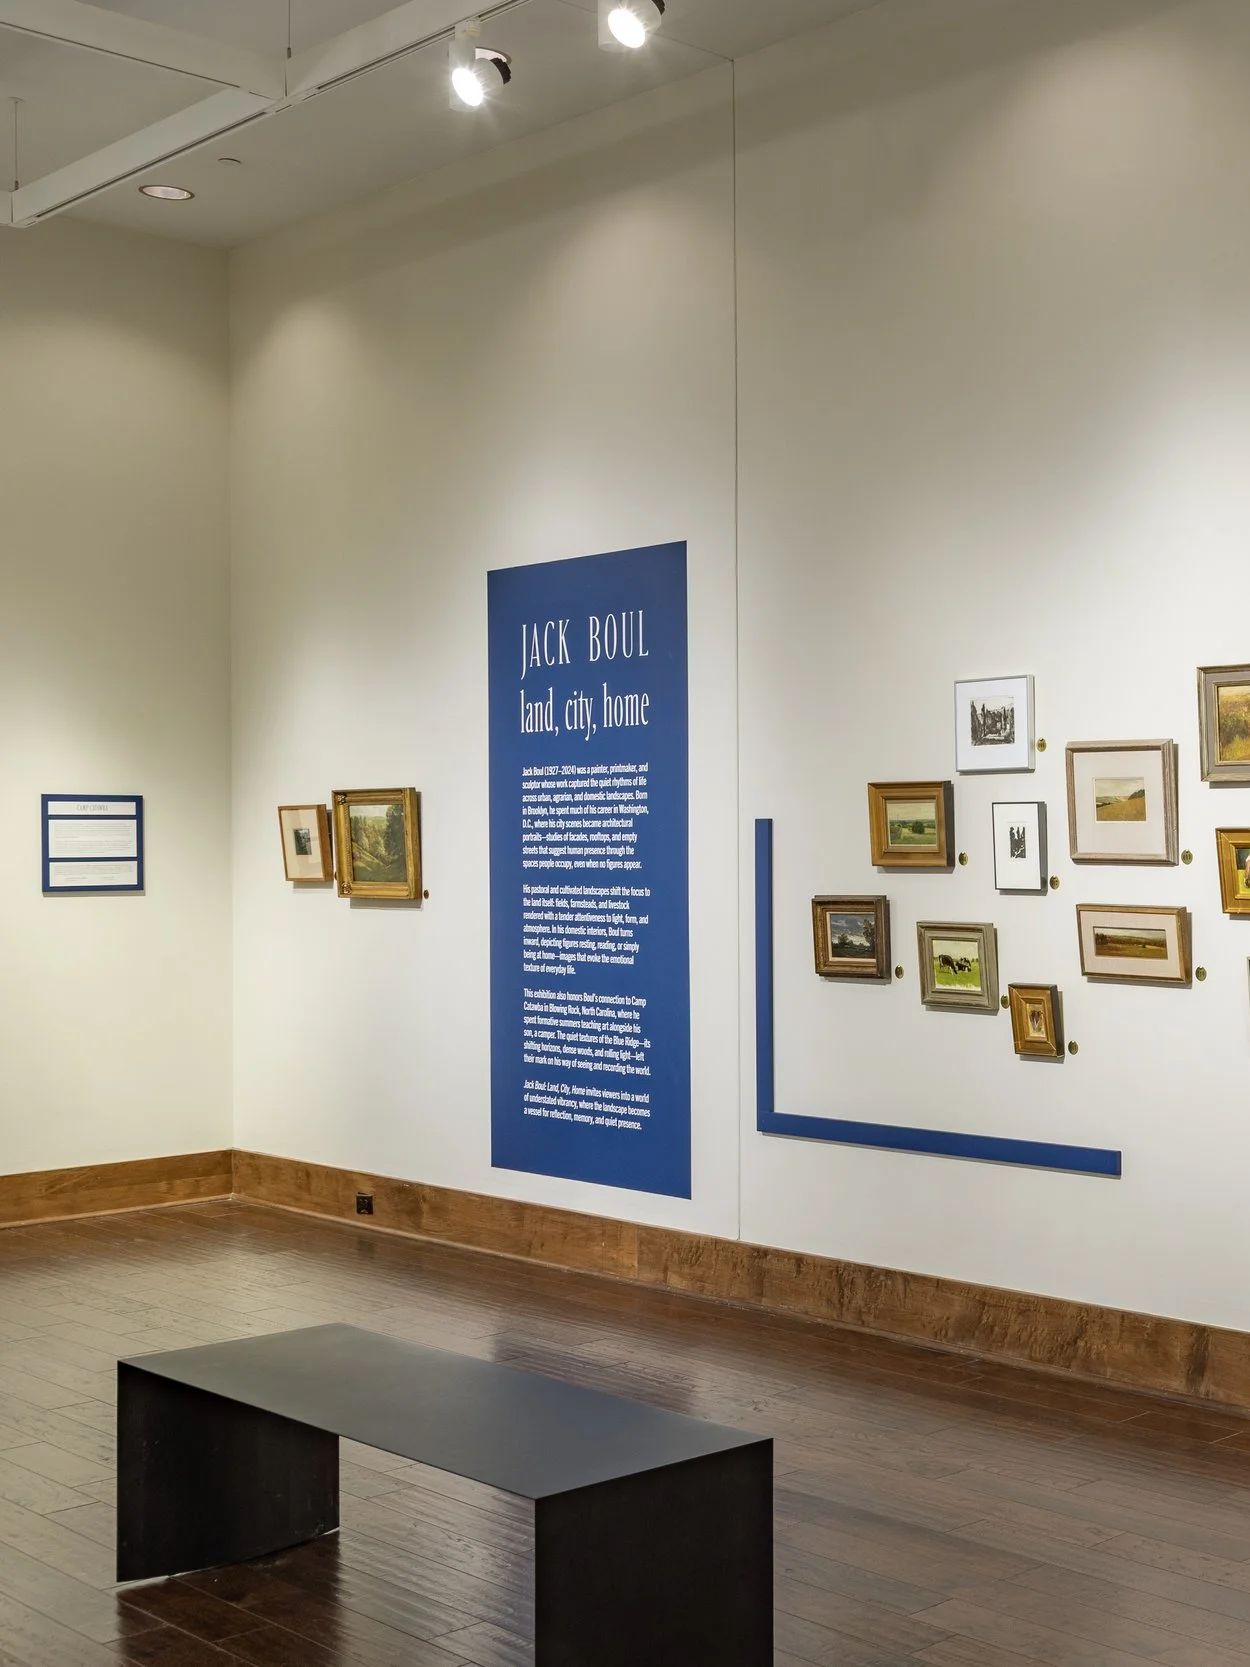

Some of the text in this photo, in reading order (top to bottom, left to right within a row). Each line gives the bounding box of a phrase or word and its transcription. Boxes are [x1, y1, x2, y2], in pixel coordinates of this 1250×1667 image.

[521, 610, 649, 680] JACK BOUL
[520, 682, 650, 741] land, city, home
[522, 767, 533, 776] Jack
[638, 763, 648, 772] and
[522, 777, 632, 791] sculptor whose work captured quiet rhythms
[584, 792, 606, 801] domestic
[636, 791, 647, 800] Born
[556, 806, 569, 816] spent
[570, 805, 583, 815] much
[534, 819, 548, 829] where
[583, 819, 601, 828] became
[602, 819, 632, 828] architectural
[622, 833, 637, 843] empty
[523, 846, 625, 857] streets suggest human presence through
[523, 861, 538, 870] spaces
[539, 859, 554, 870] people
[574, 861, 585, 869] even
[586, 859, 599, 869] when
[606, 860, 623, 870] figures
[531, 885, 644, 898] pastoral cultivated landscapes shift focus
[532, 898, 541, 907] land
[608, 900, 630, 910] livestock
[523, 911, 543, 920] rendered
[544, 911, 554, 921] with
[559, 912, 574, 922] tender
[575, 913, 605, 923] attentiveness
[639, 915, 648, 925] and
[565, 925, 586, 935] domestic
[609, 927, 619, 937] Boul
[620, 928, 633, 937] turns
[541, 937, 562, 949] depicting
[563, 939, 578, 950] figures
[623, 942, 639, 953] simply
[524, 950, 536, 961] being
[587, 953, 601, 963] evoke
[610, 955, 634, 965] emotional
[524, 963, 566, 976] texture everyday
[534, 990, 556, 1000] exhibition
[567, 992, 582, 1002] honors
[599, 994, 625, 1005] connection
[632, 997, 646, 1009] Camp
[524, 1002, 543, 1012] Catawba
[549, 1004, 567, 1016] Blowing
[582, 1006, 595, 1016] North
[618, 1009, 632, 1019] where
[524, 1016, 632, 1035] spent formative summers teaching alongside
[567, 1032, 578, 1044] quiet
[579, 1034, 598, 1044] textures
[613, 1036, 624, 1046] Blue
[524, 1041, 541, 1053] shifting
[563, 1045, 576, 1055] dense
[605, 1049, 619, 1061] rolling
[524, 1054, 534, 1064] their
[535, 1055, 547, 1065] mark
[578, 1059, 592, 1071] seeing
[603, 1062, 626, 1075] recording
[524, 1080, 534, 1090] Jack
[572, 1086, 585, 1096] Home
[586, 1087, 601, 1098] invites
[602, 1089, 620, 1100] viewers
[635, 1093, 649, 1104] world
[530, 1094, 556, 1106] understated
[579, 1100, 593, 1111] where
[603, 1103, 627, 1116] landscape
[628, 1106, 650, 1118] becomes
[528, 1107, 542, 1118] vessel
[605, 1117, 617, 1129] quiet
